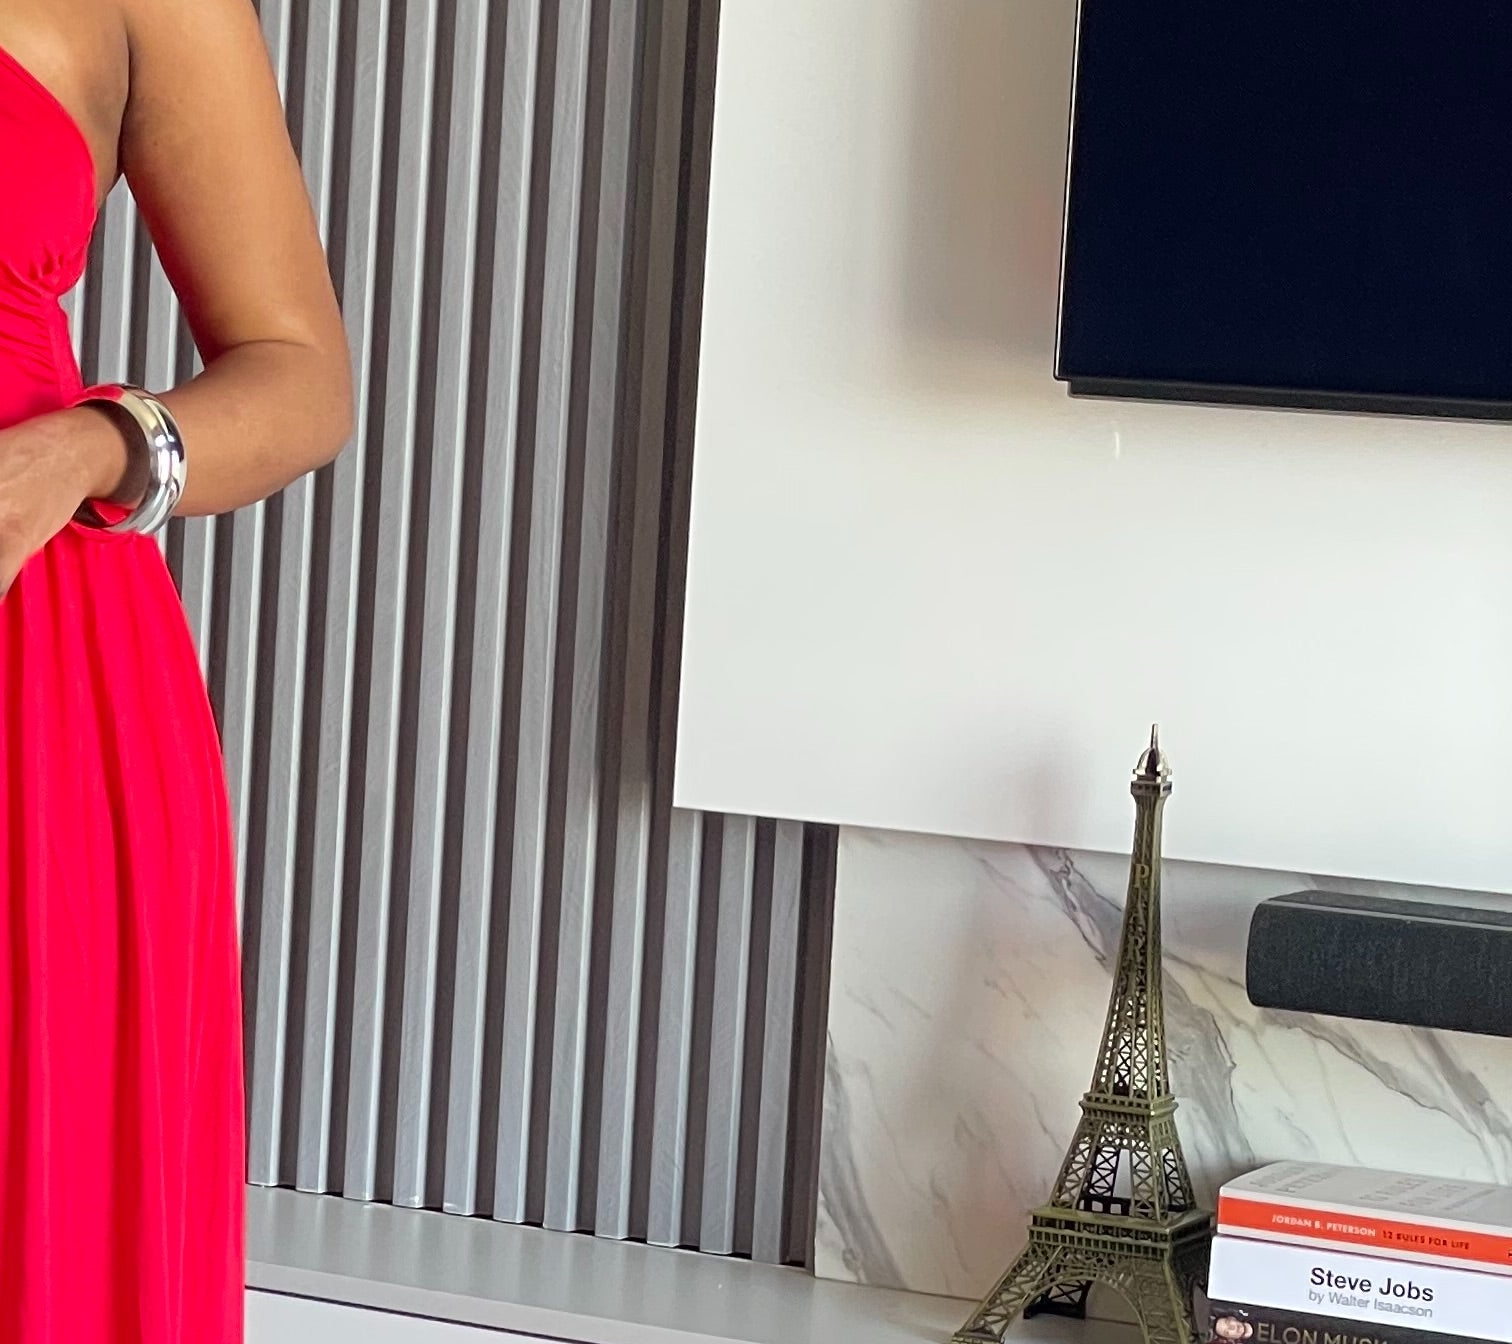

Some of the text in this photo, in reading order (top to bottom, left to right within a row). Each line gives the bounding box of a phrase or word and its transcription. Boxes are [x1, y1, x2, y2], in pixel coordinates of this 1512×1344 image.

[1272, 1215, 1470, 1251] JORDAN B. PETERSON 12 RULES FOR LIFE
[1310, 1266, 1434, 1302] Steve Jobs
[1308, 1290, 1433, 1318] by Walter Isaacson
